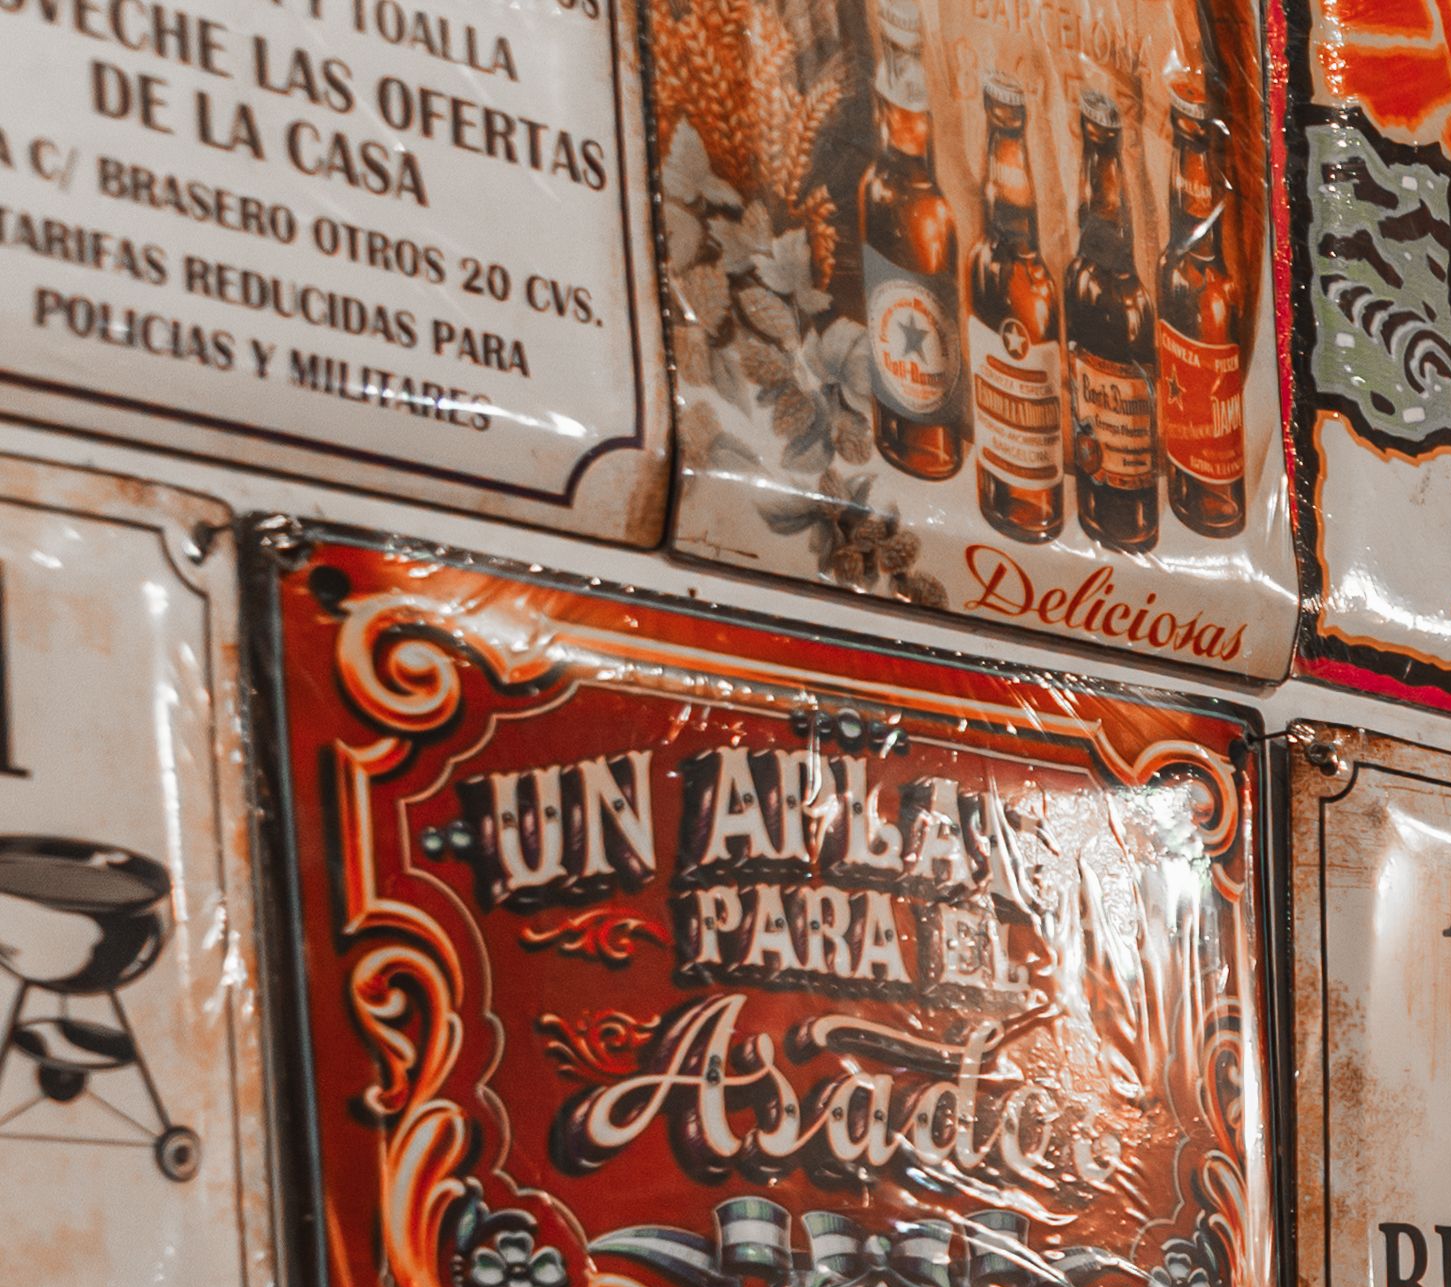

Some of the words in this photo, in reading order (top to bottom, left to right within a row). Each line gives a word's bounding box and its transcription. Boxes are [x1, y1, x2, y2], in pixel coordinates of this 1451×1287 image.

[91, 59, 174, 135] DE
[196, 91, 266, 160] LA
[287, 120, 431, 208] CASA
[253, 35, 355, 115] LAS
[377, 75, 607, 191] OFERTAS
[97, 156, 297, 246] BRASERO
[313, 214, 446, 285] OTROS
[461, 257, 510, 303] 20
[526, 274, 604, 328] CVS.
[35, 288, 235, 371] POLICIAS
[252, 337, 274, 377] Y
[290, 352, 493, 431] MILITARES
[184, 253, 417, 348] REDUCIDAS
[432, 318, 530, 378] PARA
[964, 544, 1248, 662] Deliciosas
[482, 746, 657, 896] UN
[693, 880, 910, 988] PARA
